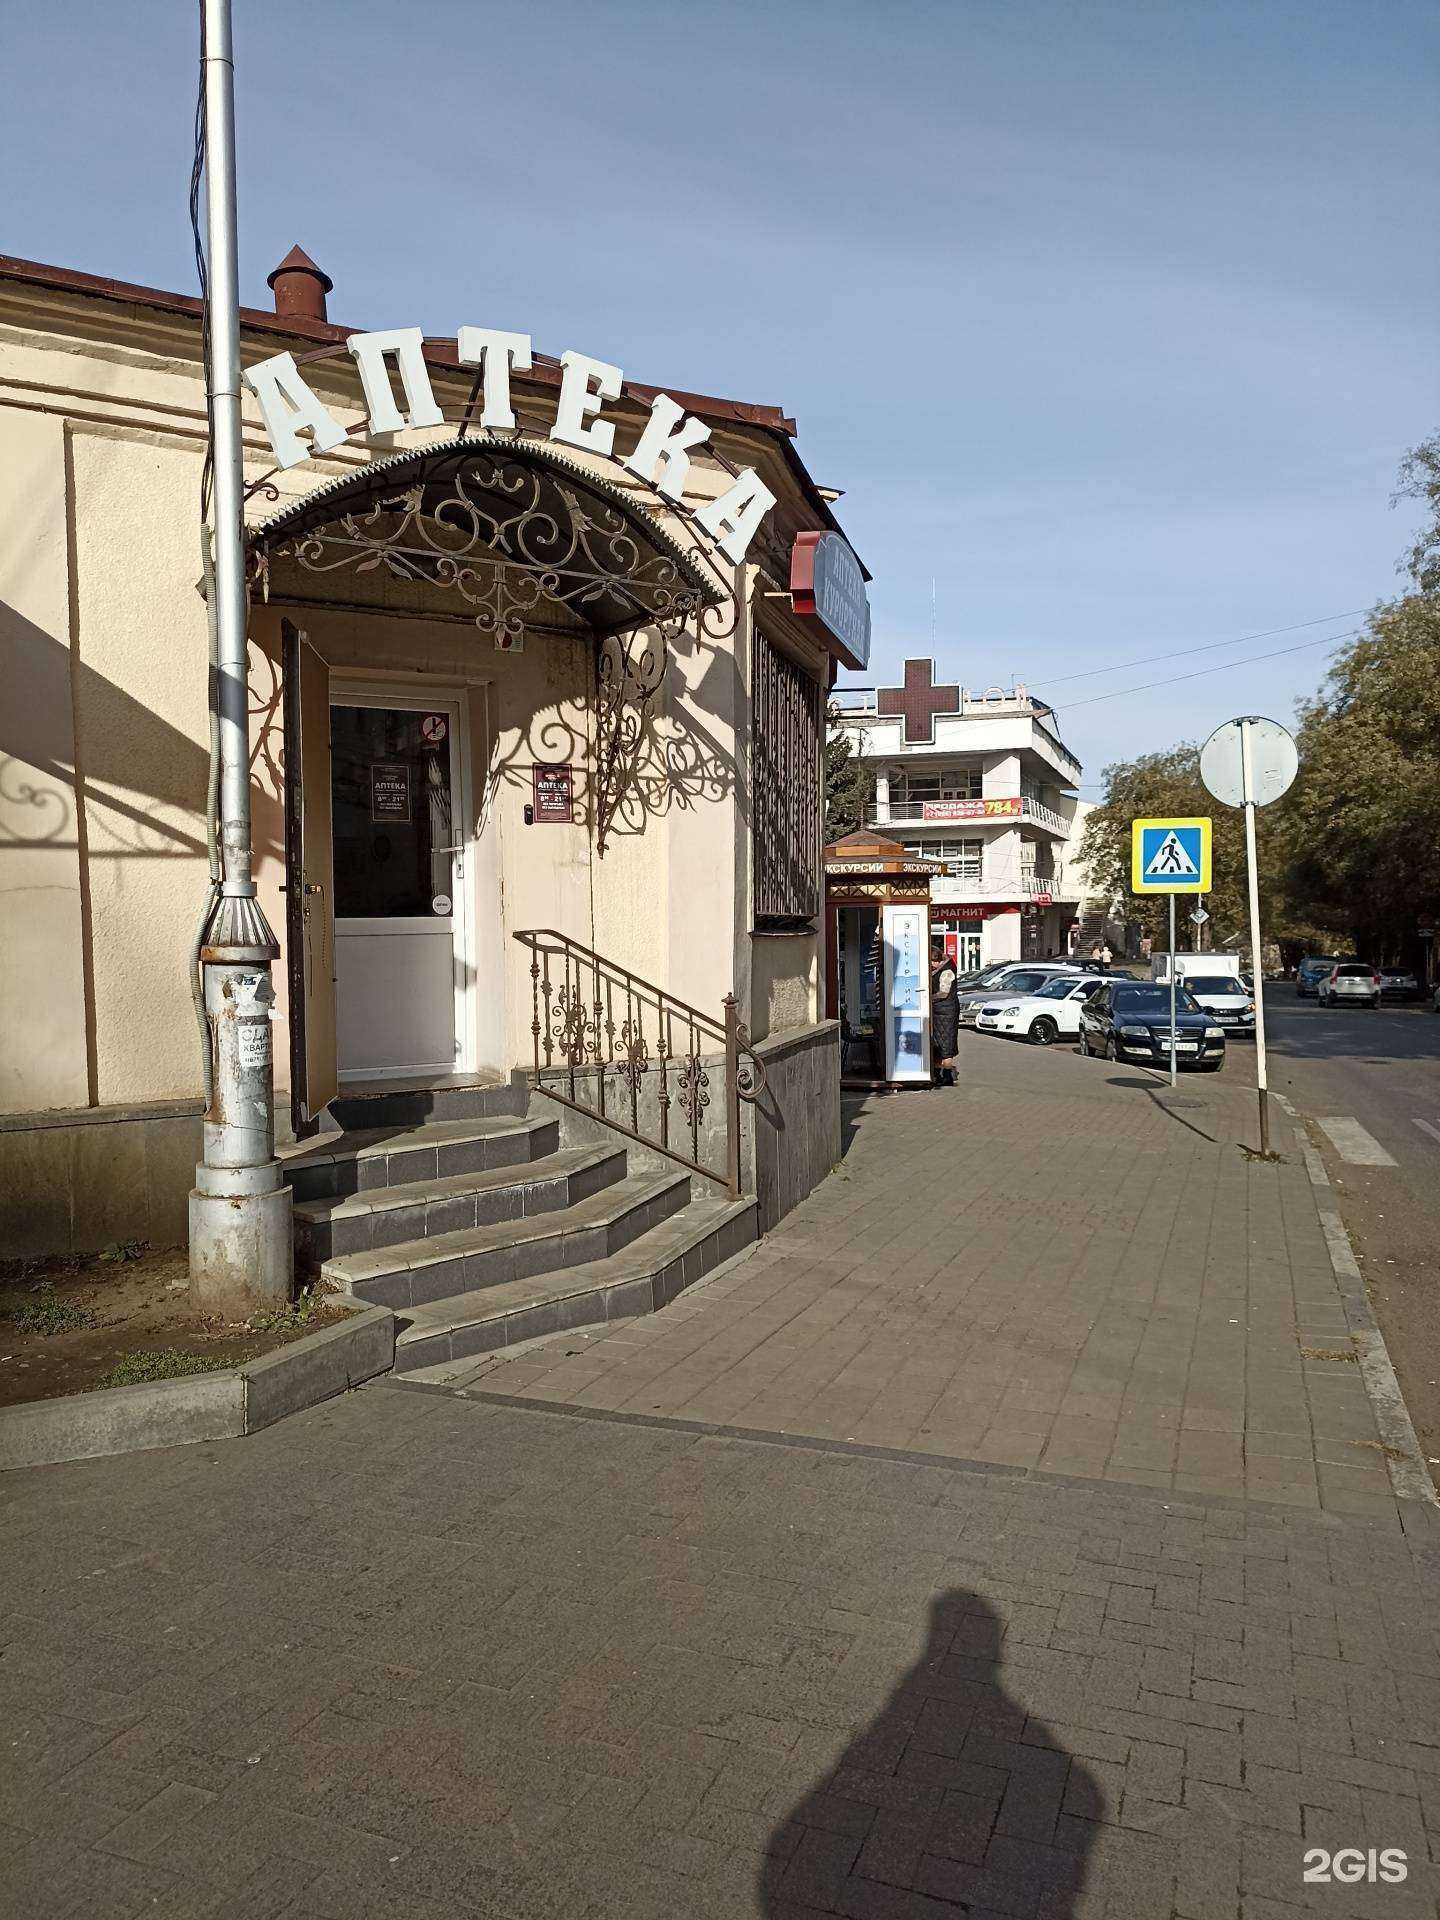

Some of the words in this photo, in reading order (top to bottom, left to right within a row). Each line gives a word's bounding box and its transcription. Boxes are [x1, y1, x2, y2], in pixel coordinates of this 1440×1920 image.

[243, 326, 777, 566] АПТЕКА
[537, 781, 568, 789] АПТЕКА
[925, 801, 984, 810] ПРОДАЖА
[825, 862, 884, 873] КСКУРСИИ
[903, 863, 942, 872] ЭКСКУРСИИ
[940, 907, 985, 917] МАГНИТ
